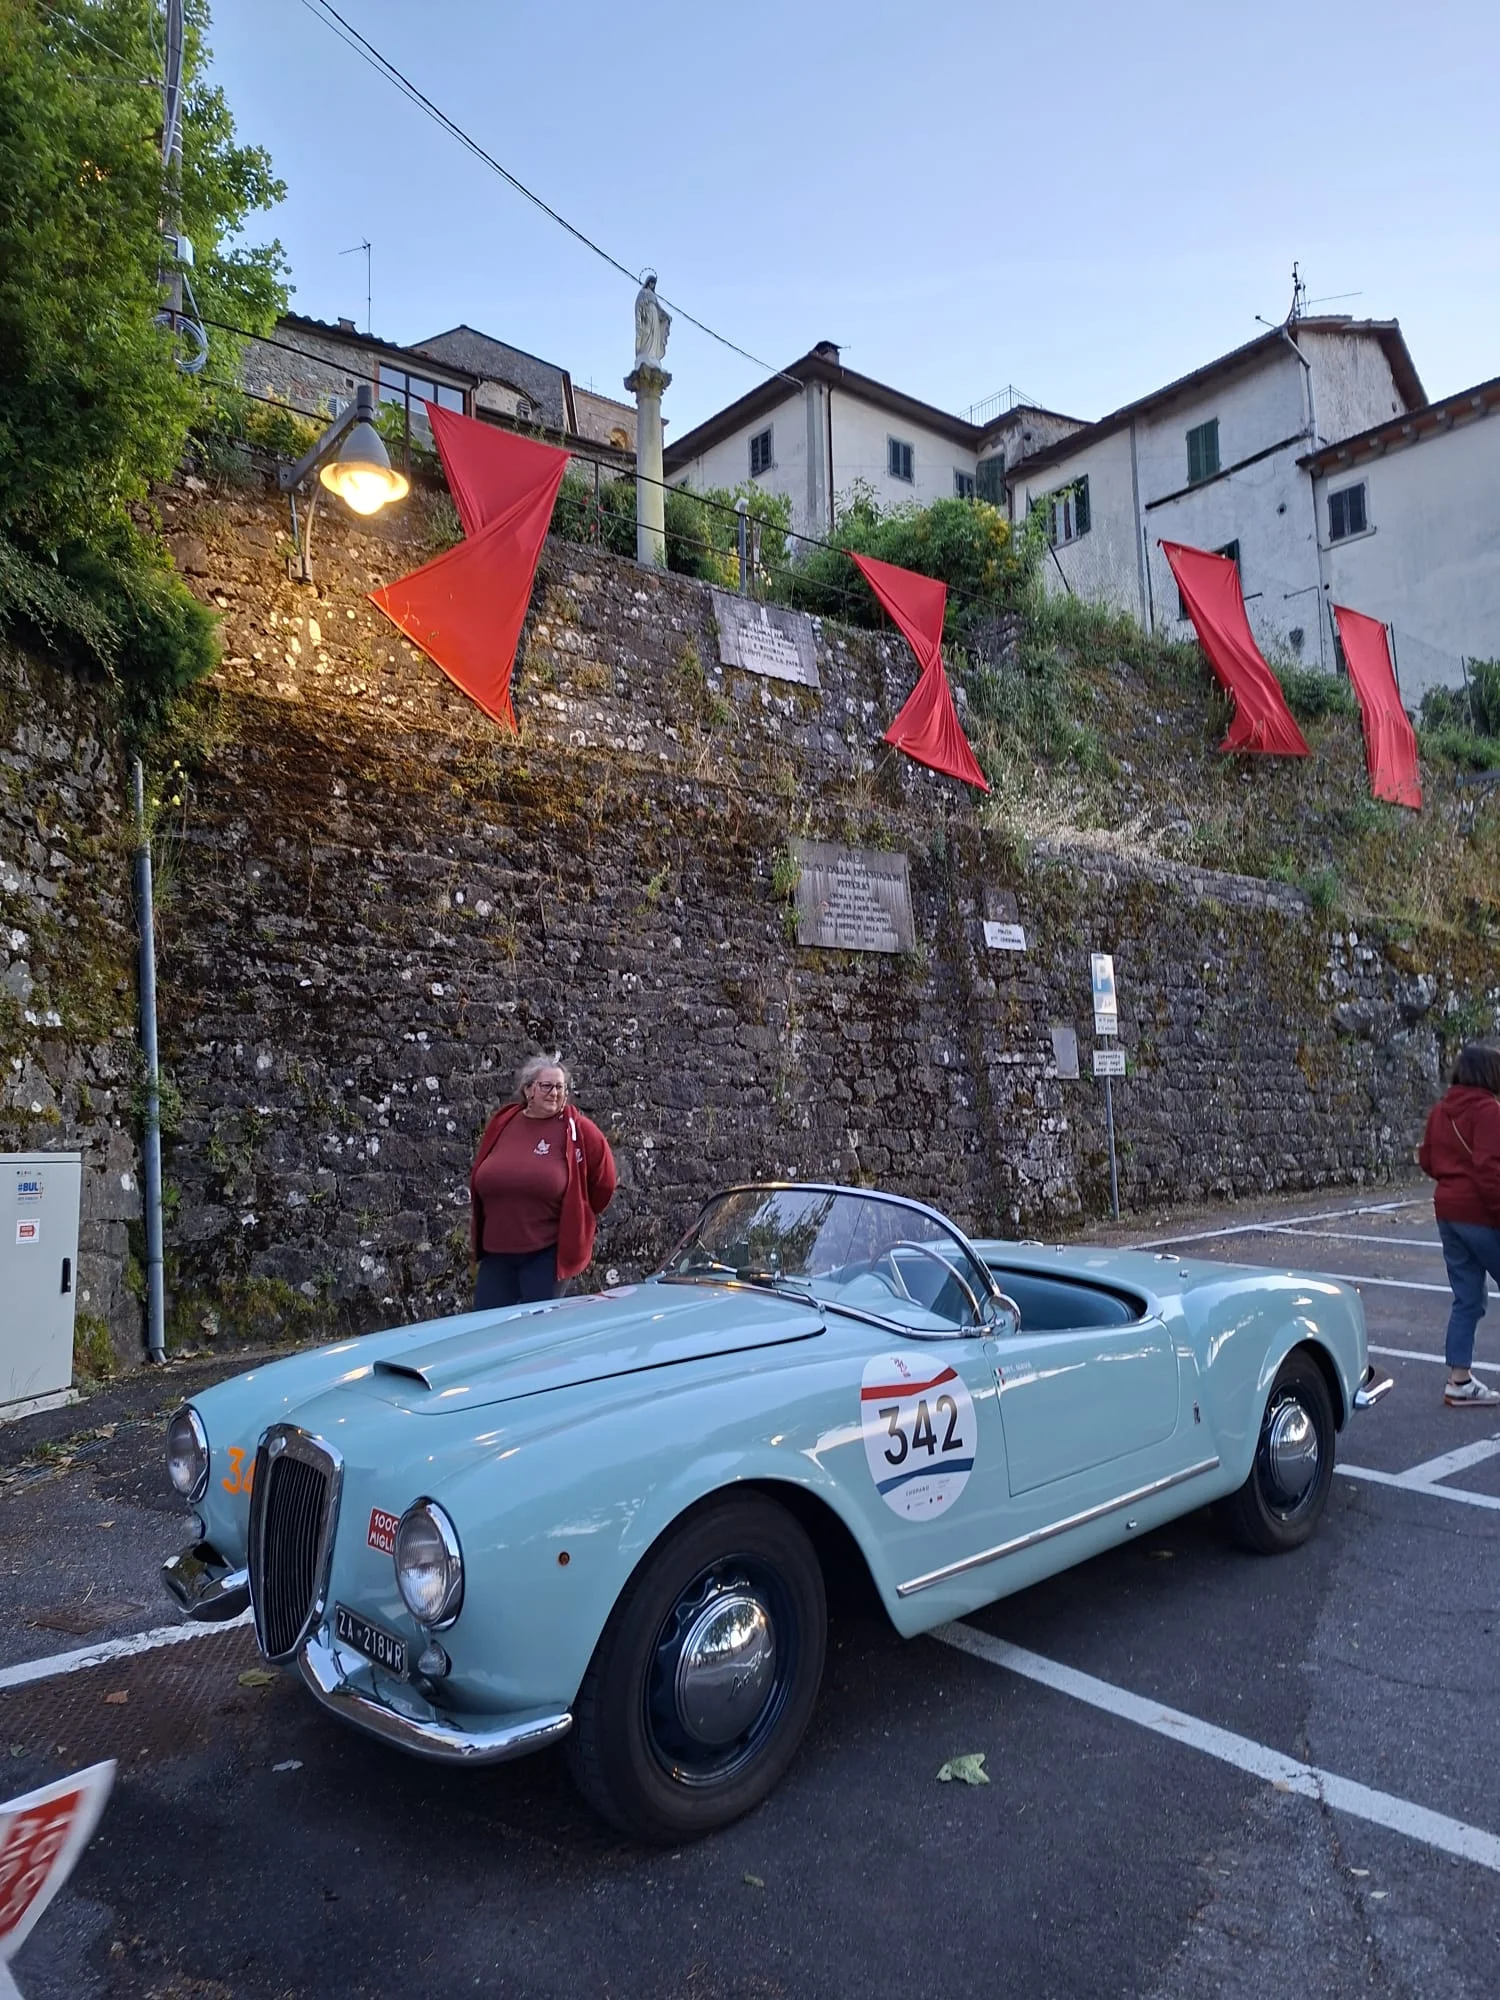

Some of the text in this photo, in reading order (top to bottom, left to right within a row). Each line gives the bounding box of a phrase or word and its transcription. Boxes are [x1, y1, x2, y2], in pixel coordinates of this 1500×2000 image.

[878, 1394, 963, 1466] 342
[339, 1611, 402, 1671] ZA 218WR
